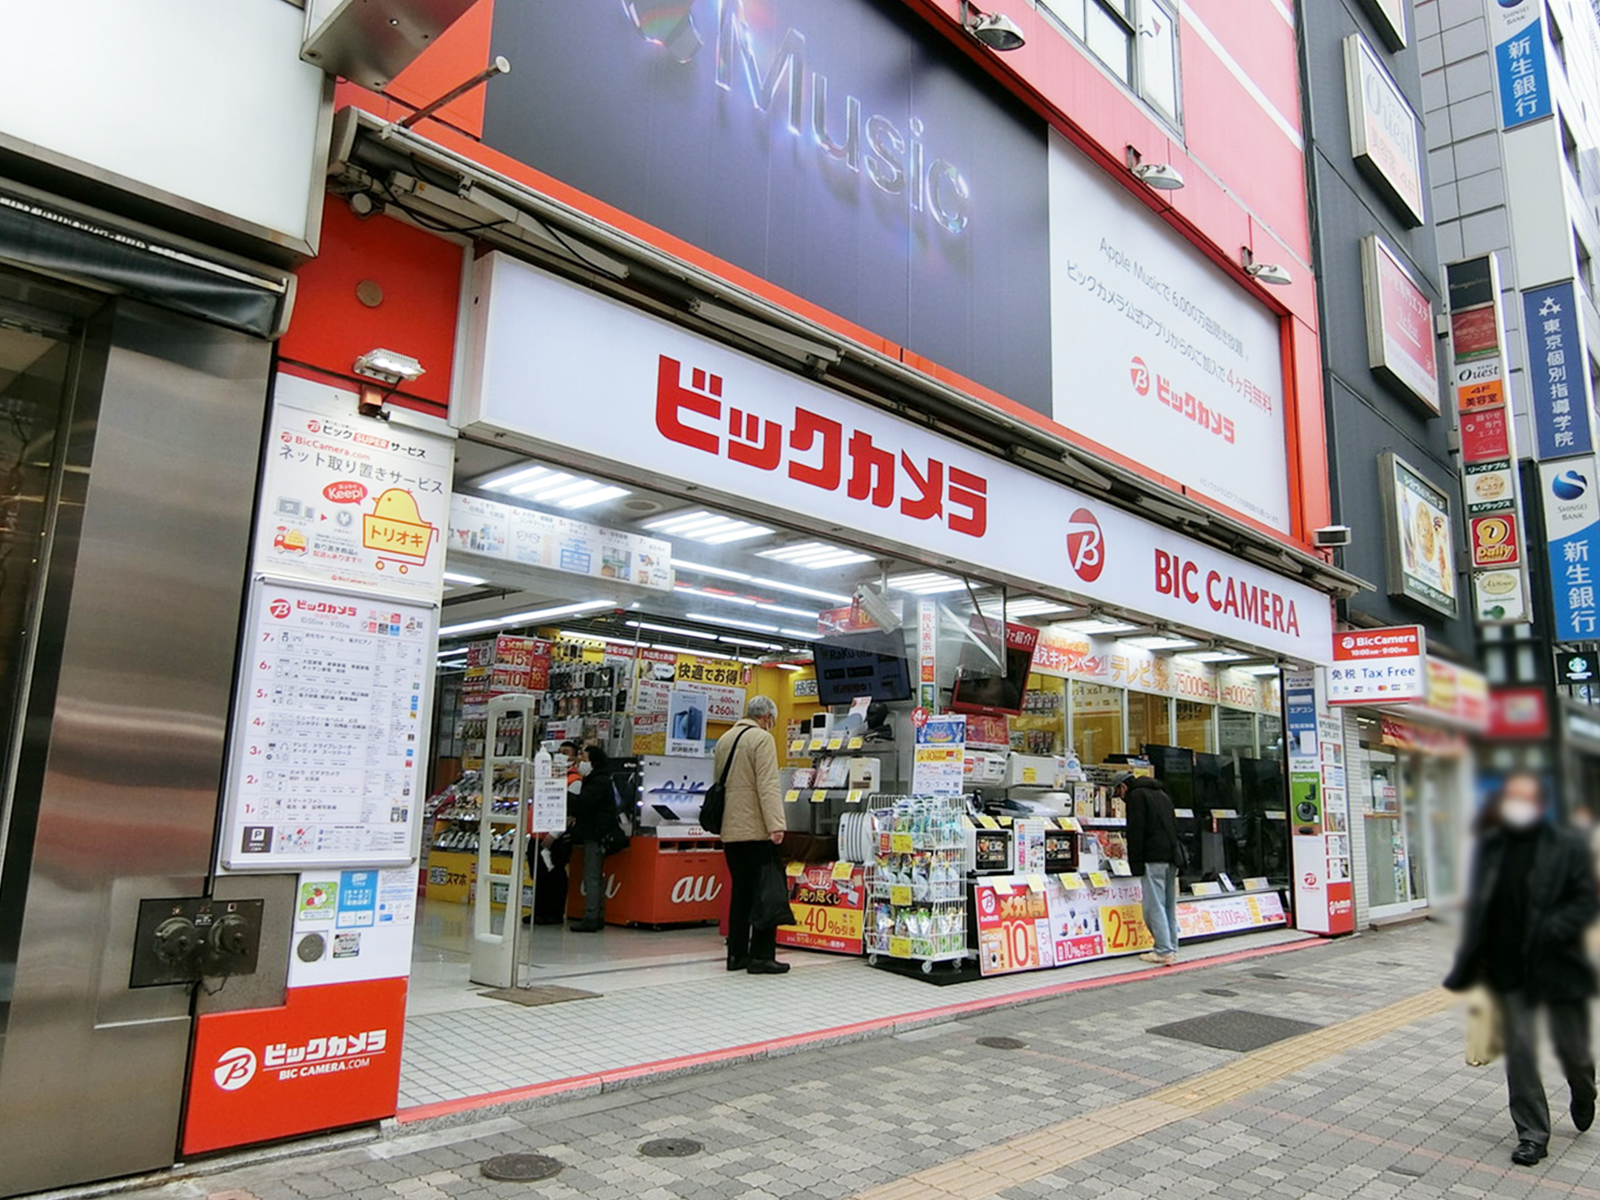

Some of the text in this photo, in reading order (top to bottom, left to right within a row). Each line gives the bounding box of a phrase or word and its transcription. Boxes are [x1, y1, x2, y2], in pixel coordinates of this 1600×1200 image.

[1507, 35, 1538, 118] 新生銀行
[715, 0, 970, 235] Music
[1099, 237, 1131, 271] Apple
[1542, 318, 1574, 448] 東京個別指導学院
[1156, 373, 1235, 445] ビックカメラ
[322, 423, 426, 458] ビック SUPER サービス
[655, 354, 988, 539] ビックカメラ
[278, 443, 444, 495] ネット取り置きサービス
[1557, 503, 1588, 513] SHINSEI
[1561, 512, 1584, 521] BANK
[370, 524, 424, 548] トリオキ
[1154, 547, 1301, 637] BIC CAMERA
[1562, 539, 1597, 634] 新生銀行
[296, 599, 357, 618] ビックカメラ
[1356, 635, 1416, 647] BicCamera
[1331, 666, 1416, 681] 免税 Tax Free
[671, 874, 722, 904] au
[263, 1029, 388, 1067] ビックカメラ
[278, 1057, 370, 1080] BIC CAMERA.COM
